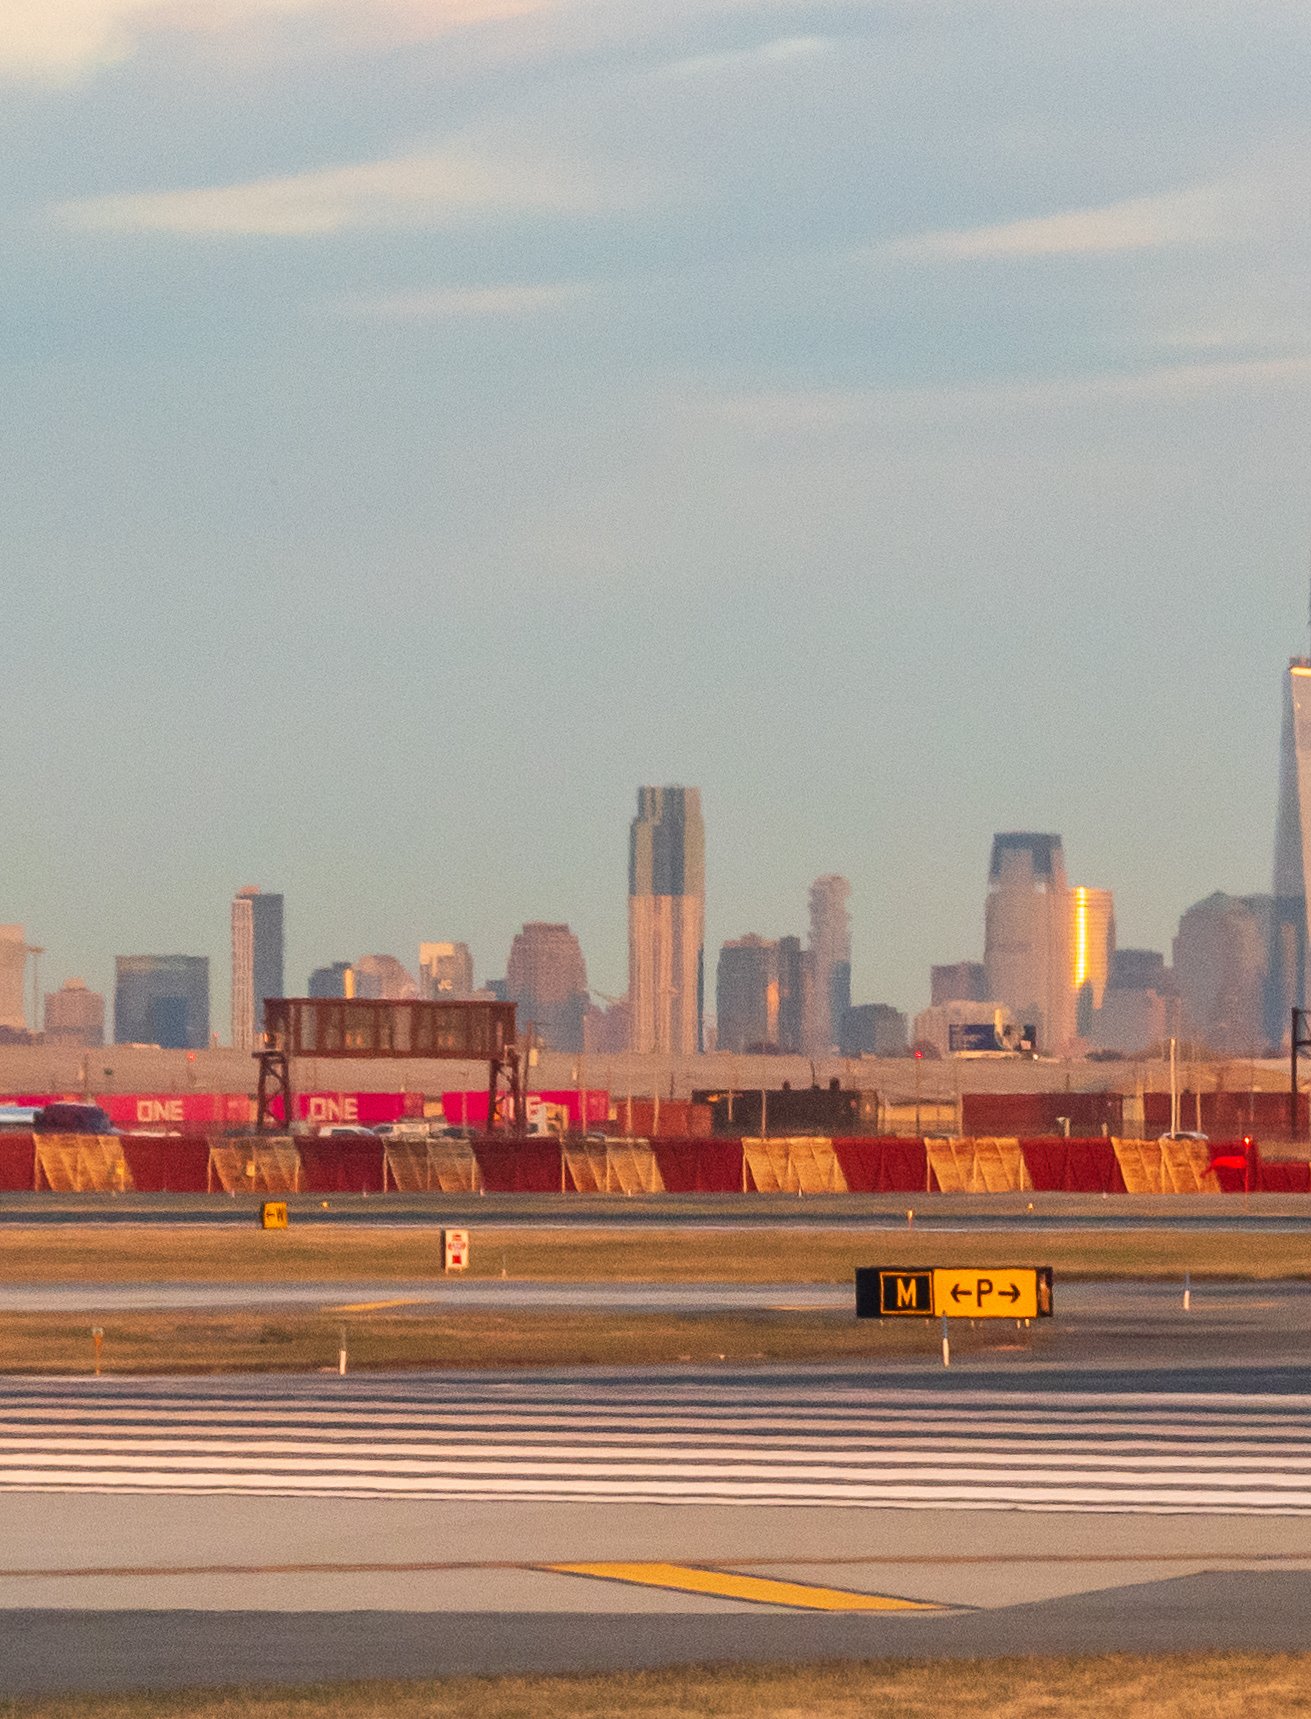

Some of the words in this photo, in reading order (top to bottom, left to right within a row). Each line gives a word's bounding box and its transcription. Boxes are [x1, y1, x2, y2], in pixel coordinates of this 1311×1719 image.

[136, 1099, 183, 1121] ONE
[309, 1097, 358, 1120] ONE
[896, 1277, 917, 1308] M
[976, 1278, 994, 1307] P
